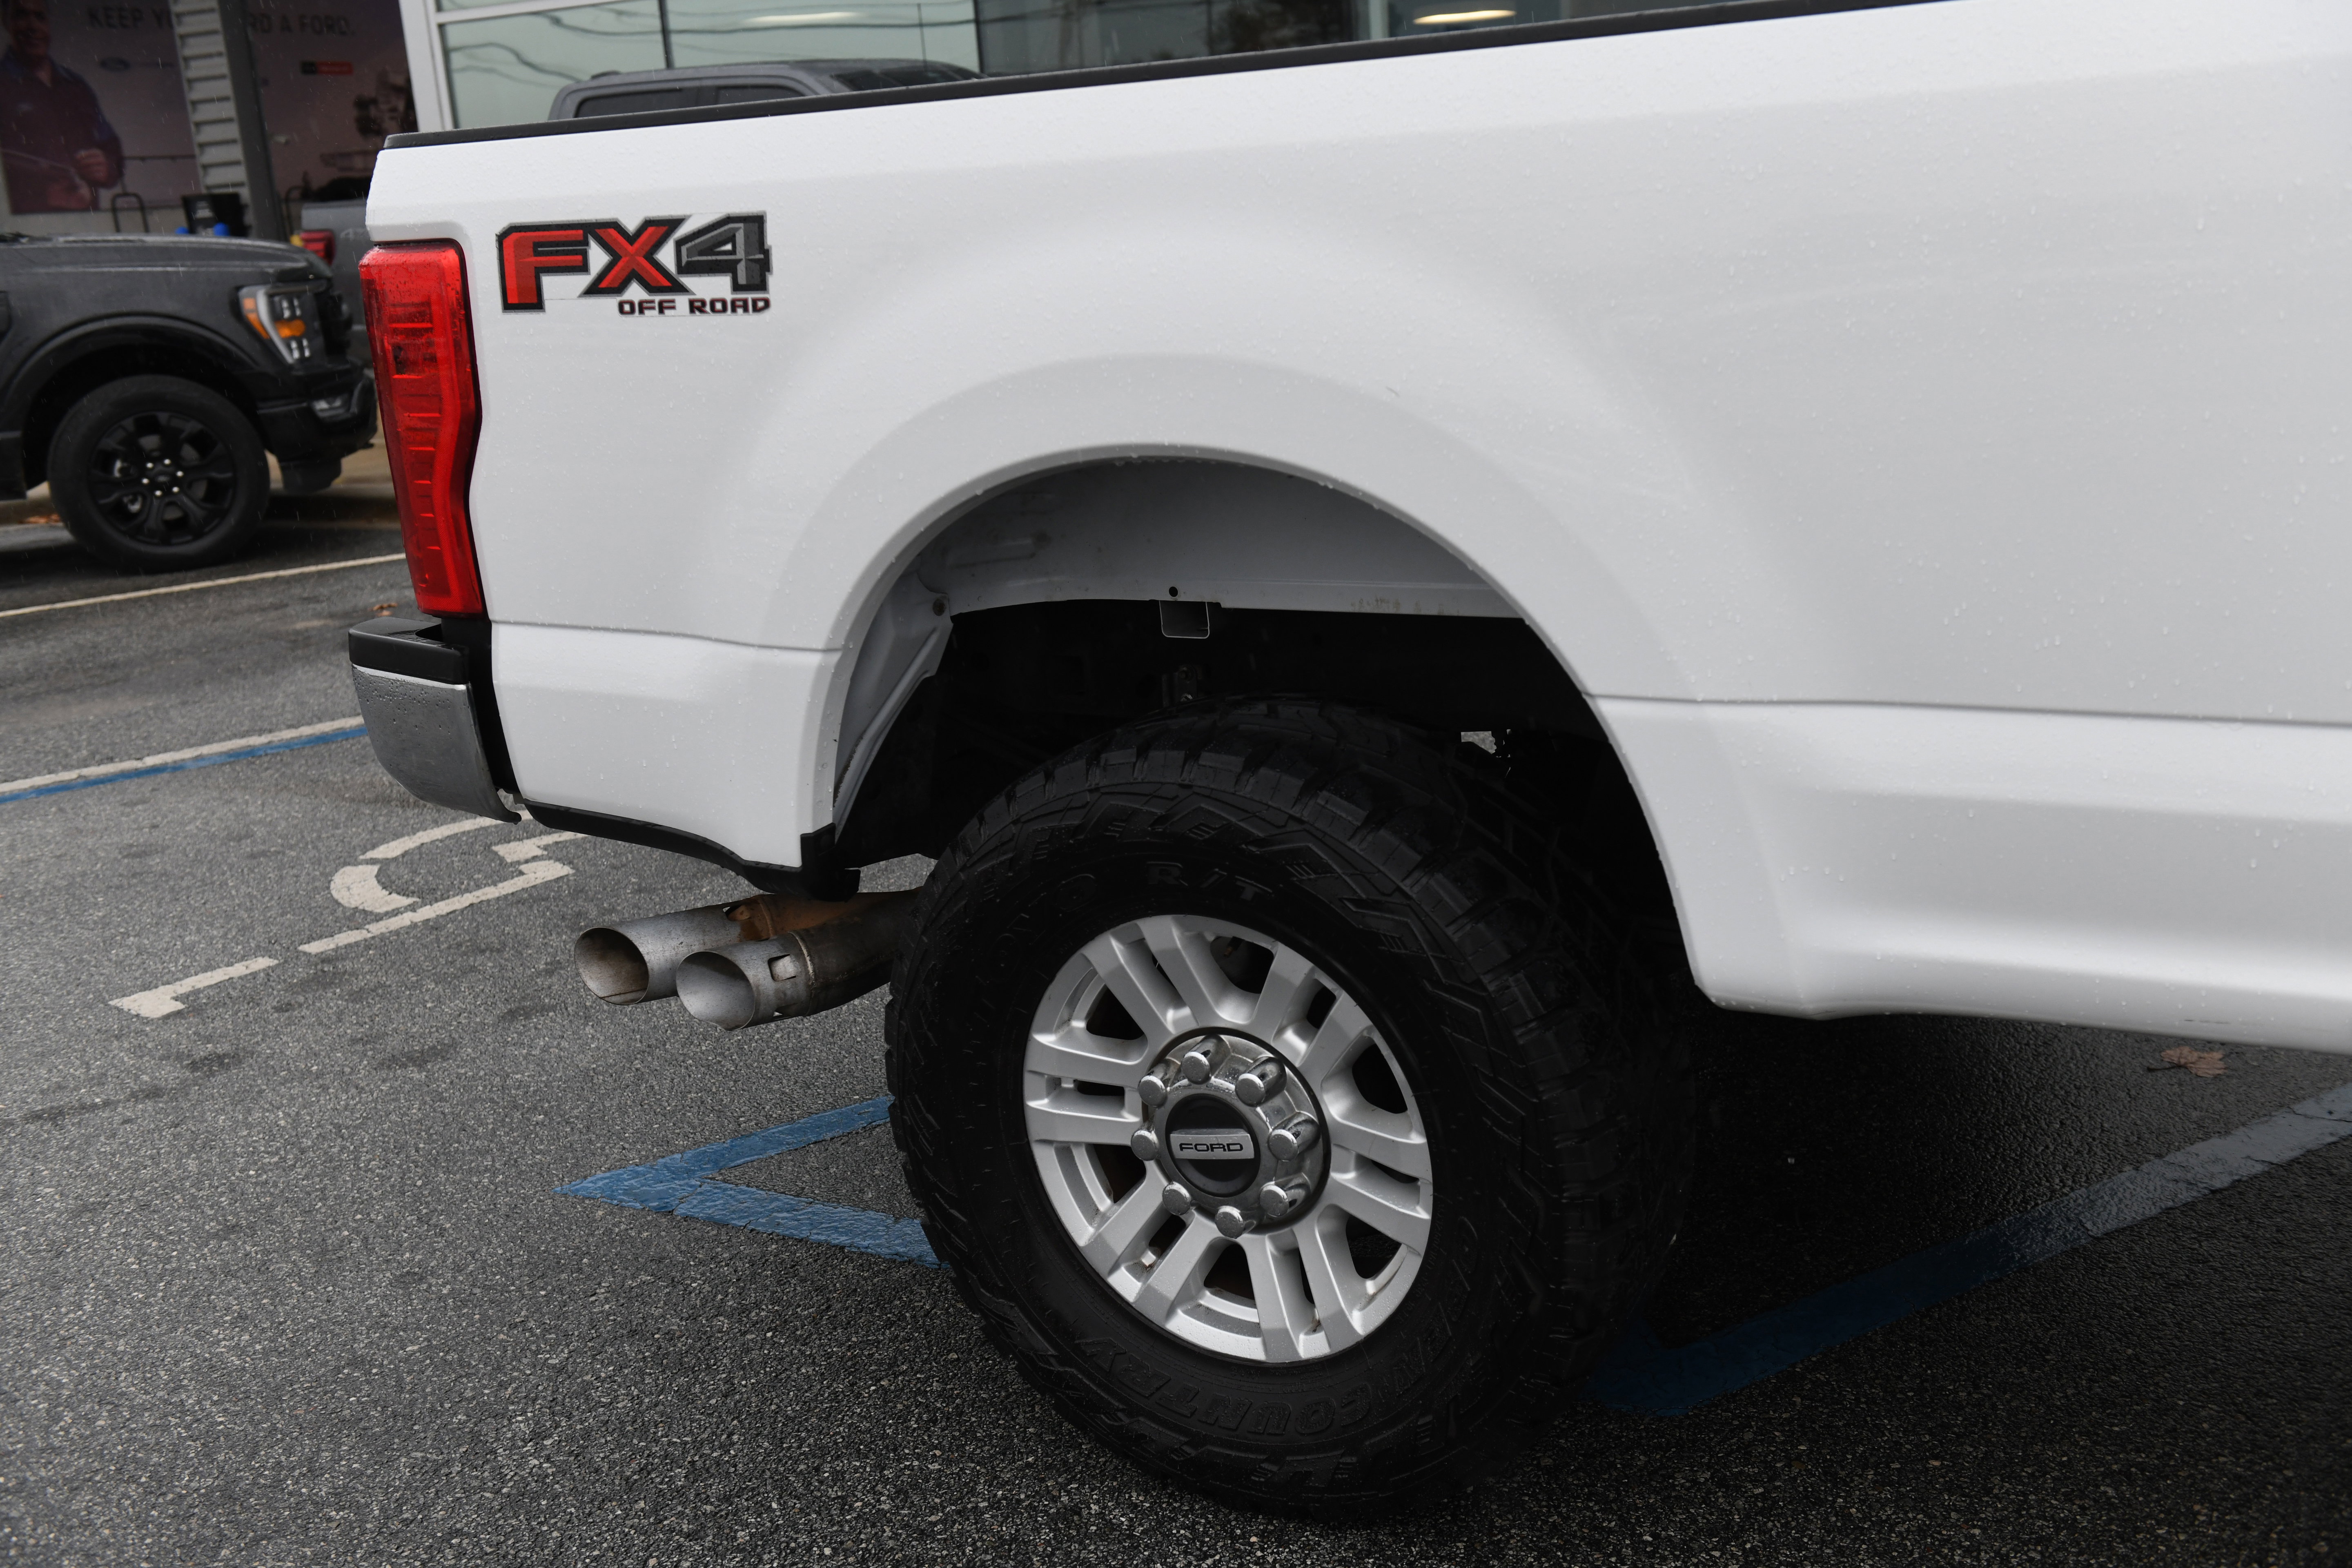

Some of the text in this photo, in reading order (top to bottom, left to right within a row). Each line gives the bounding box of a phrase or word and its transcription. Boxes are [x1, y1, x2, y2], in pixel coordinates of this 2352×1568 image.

[88, 7, 143, 29] KEEP
[281, 14, 293, 33] A
[496, 210, 773, 313] FX4
[618, 297, 770, 315] OFF ROAD
[1145, 861, 1273, 902] R/T
[964, 872, 1098, 1029] TOYO
[1179, 1143, 1243, 1152] FORD
[1390, 1215, 1480, 1399] OPEN
[1075, 1337, 1369, 1435] COUNTRY
